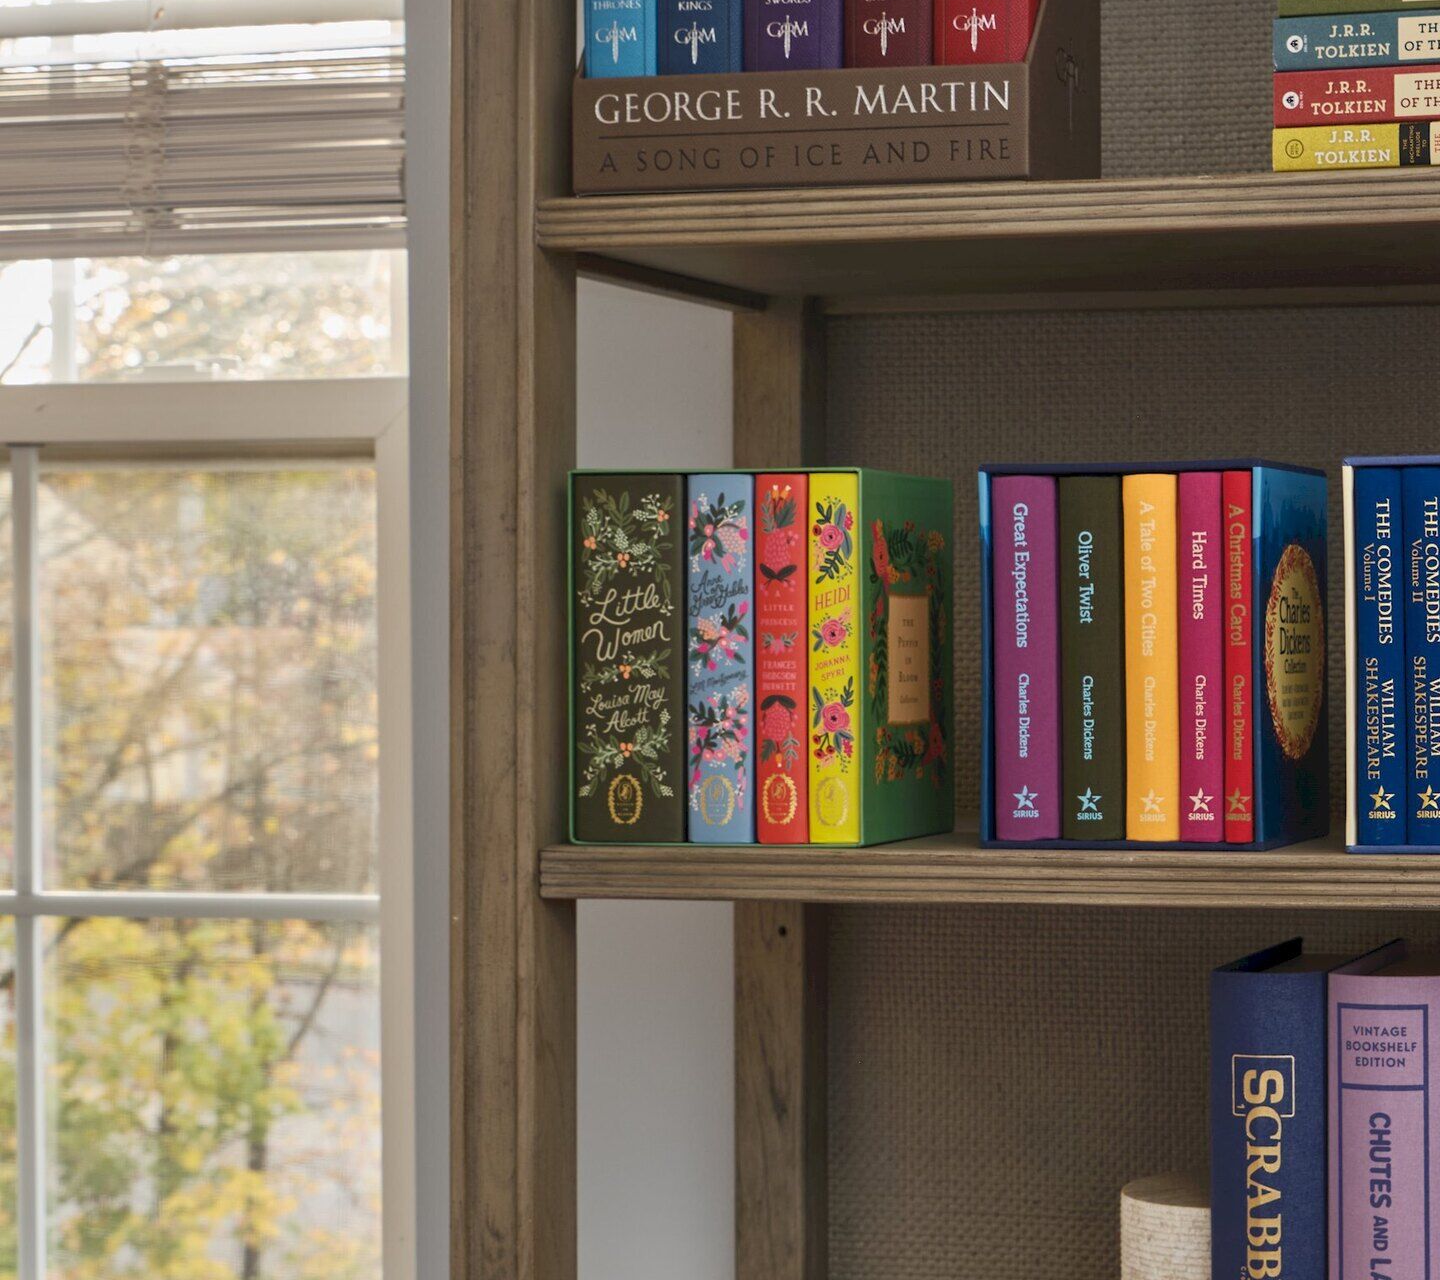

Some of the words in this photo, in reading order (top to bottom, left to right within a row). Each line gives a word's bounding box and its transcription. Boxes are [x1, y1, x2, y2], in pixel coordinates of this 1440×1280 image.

[1329, 24, 1375, 38] J.R.R.
[1405, 41, 1423, 51] OF
[1315, 43, 1390, 59] TOLKIEN
[595, 89, 742, 124] GEORGE
[759, 87, 790, 119] R.
[806, 86, 837, 116] R.
[854, 80, 1010, 115] MARTIN
[1326, 81, 1371, 94] J.R.R.
[1401, 98, 1419, 108] OF
[1311, 100, 1386, 115] TOLKIEN
[600, 154, 618, 173] A
[637, 148, 720, 171] SONG
[740, 146, 776, 169] OF
[794, 143, 842, 167] ICE
[863, 140, 931, 164] AND
[950, 138, 1010, 161] FIRE
[1329, 130, 1375, 143] J.R.R.
[1315, 149, 1390, 165] TOLKIEN
[1012, 503, 1029, 547] Great
[1228, 504, 1244, 518] A
[1376, 499, 1391, 539] THE
[1424, 497, 1438, 537] THE
[1079, 531, 1092, 577] Oliver
[1192, 532, 1207, 569] Hard
[1229, 522, 1244, 601] Christmas
[589, 584, 661, 625] Little
[815, 585, 850, 610] HEIDI
[1012, 552, 1029, 648] Expectations
[1079, 584, 1094, 624] Twist
[1193, 574, 1207, 619] Times
[1377, 543, 1392, 645] COMEDIES
[1424, 541, 1440, 643] COMEDIES
[581, 621, 670, 662] Women
[1230, 604, 1246, 646] Carol
[815, 656, 851, 671] JOHANNA
[821, 668, 845, 681] SPYRI
[586, 694, 630, 716] Louisa
[629, 683, 669, 708] May
[1018, 674, 1029, 715] Charles
[602, 709, 649, 733] Alcott
[1365, 658, 1380, 780] SHAKESPEARE
[1381, 679, 1395, 758] WILLIAM
[1414, 657, 1428, 779] SHAKESPEARE
[1020, 718, 1030, 758] Dickens
[1345, 1040, 1418, 1053] BOOKSHELF
[1353, 1027, 1407, 1038] VINTAGE
[1355, 1056, 1406, 1068] EDITION
[1369, 1112, 1392, 1209] CHUTES
[1373, 1217, 1387, 1251] AND
